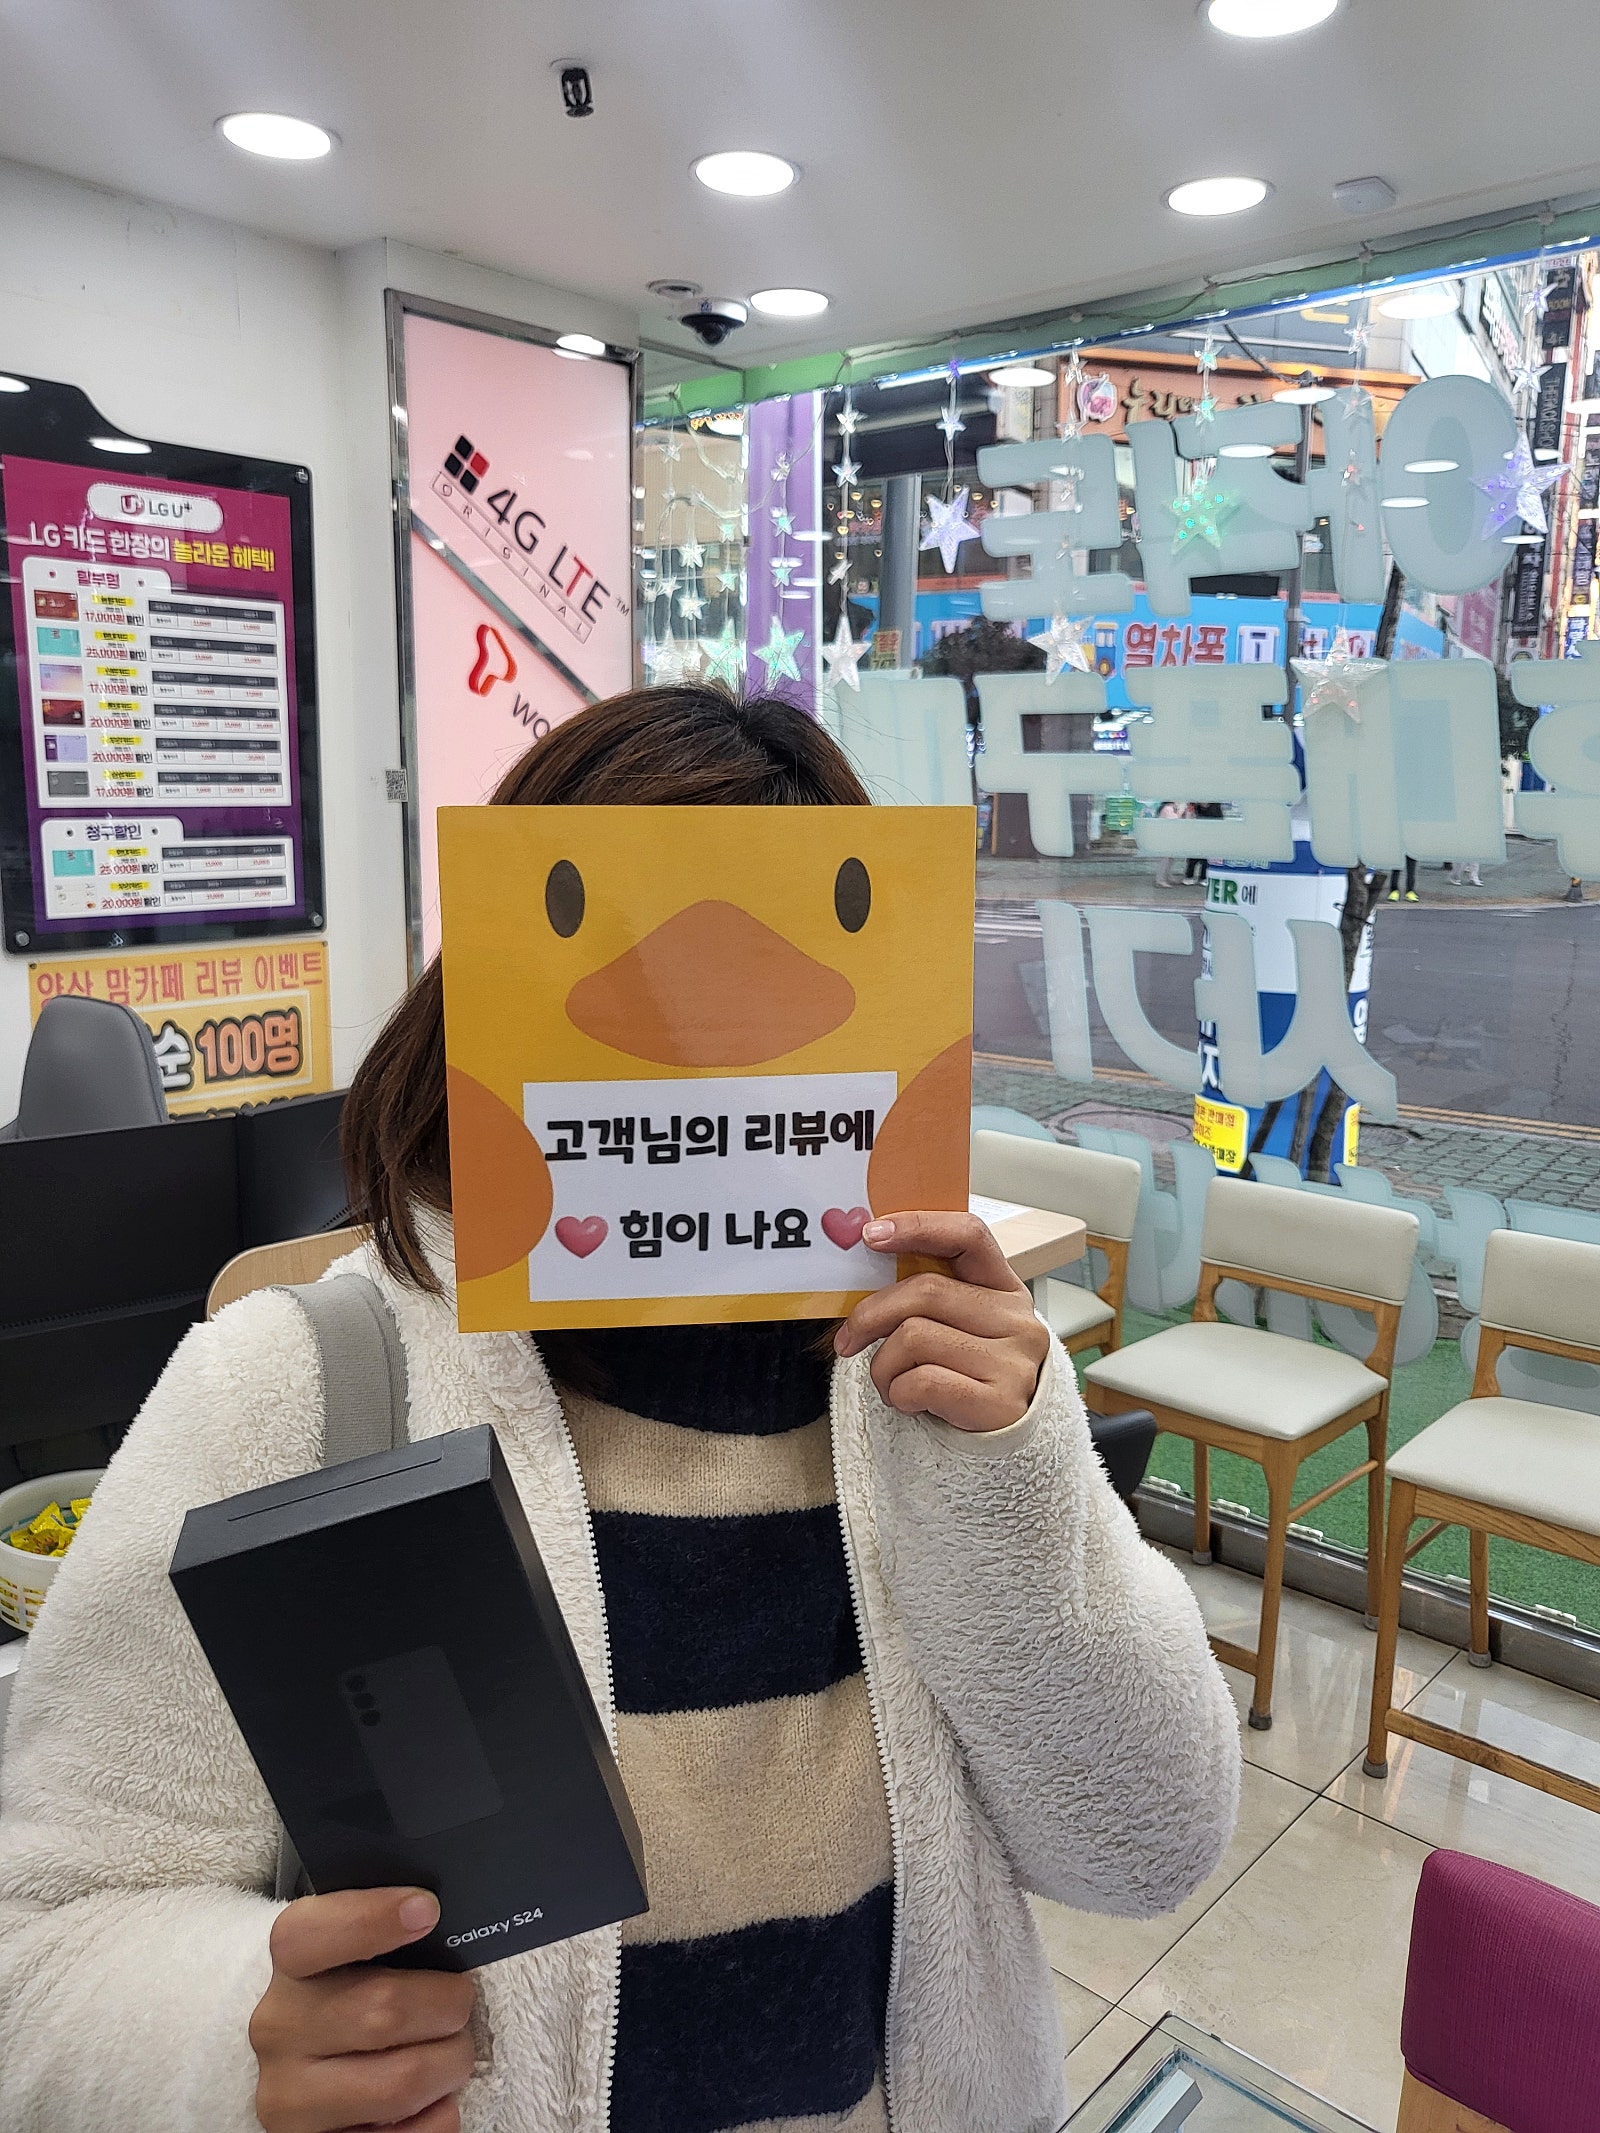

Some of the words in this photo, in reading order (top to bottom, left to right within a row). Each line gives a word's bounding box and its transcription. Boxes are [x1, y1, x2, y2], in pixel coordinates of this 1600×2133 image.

[149, 501, 169, 516] LG
[29, 520, 61, 548] LG
[63, 523, 108, 554] 카드
[109, 529, 171, 561] 한장의
[171, 538, 231, 569] 놀라운
[231, 543, 276, 573] 혜택!
[487, 488, 546, 555] 4G
[549, 545, 611, 624] LTE
[106, 963, 186, 1003] 맘카페
[197, 957, 243, 997] 리뷰
[254, 951, 324, 993] 이벤트
[196, 1007, 303, 1082] 100명
[544, 1114, 729, 1165] 고객님의
[744, 1109, 875, 1157] 리뷰에
[619, 1208, 710, 1258] 힘이
[726, 1207, 812, 1251] 나요
[446, 1919, 511, 1948] Galaxy
[513, 1907, 544, 1927] S24
